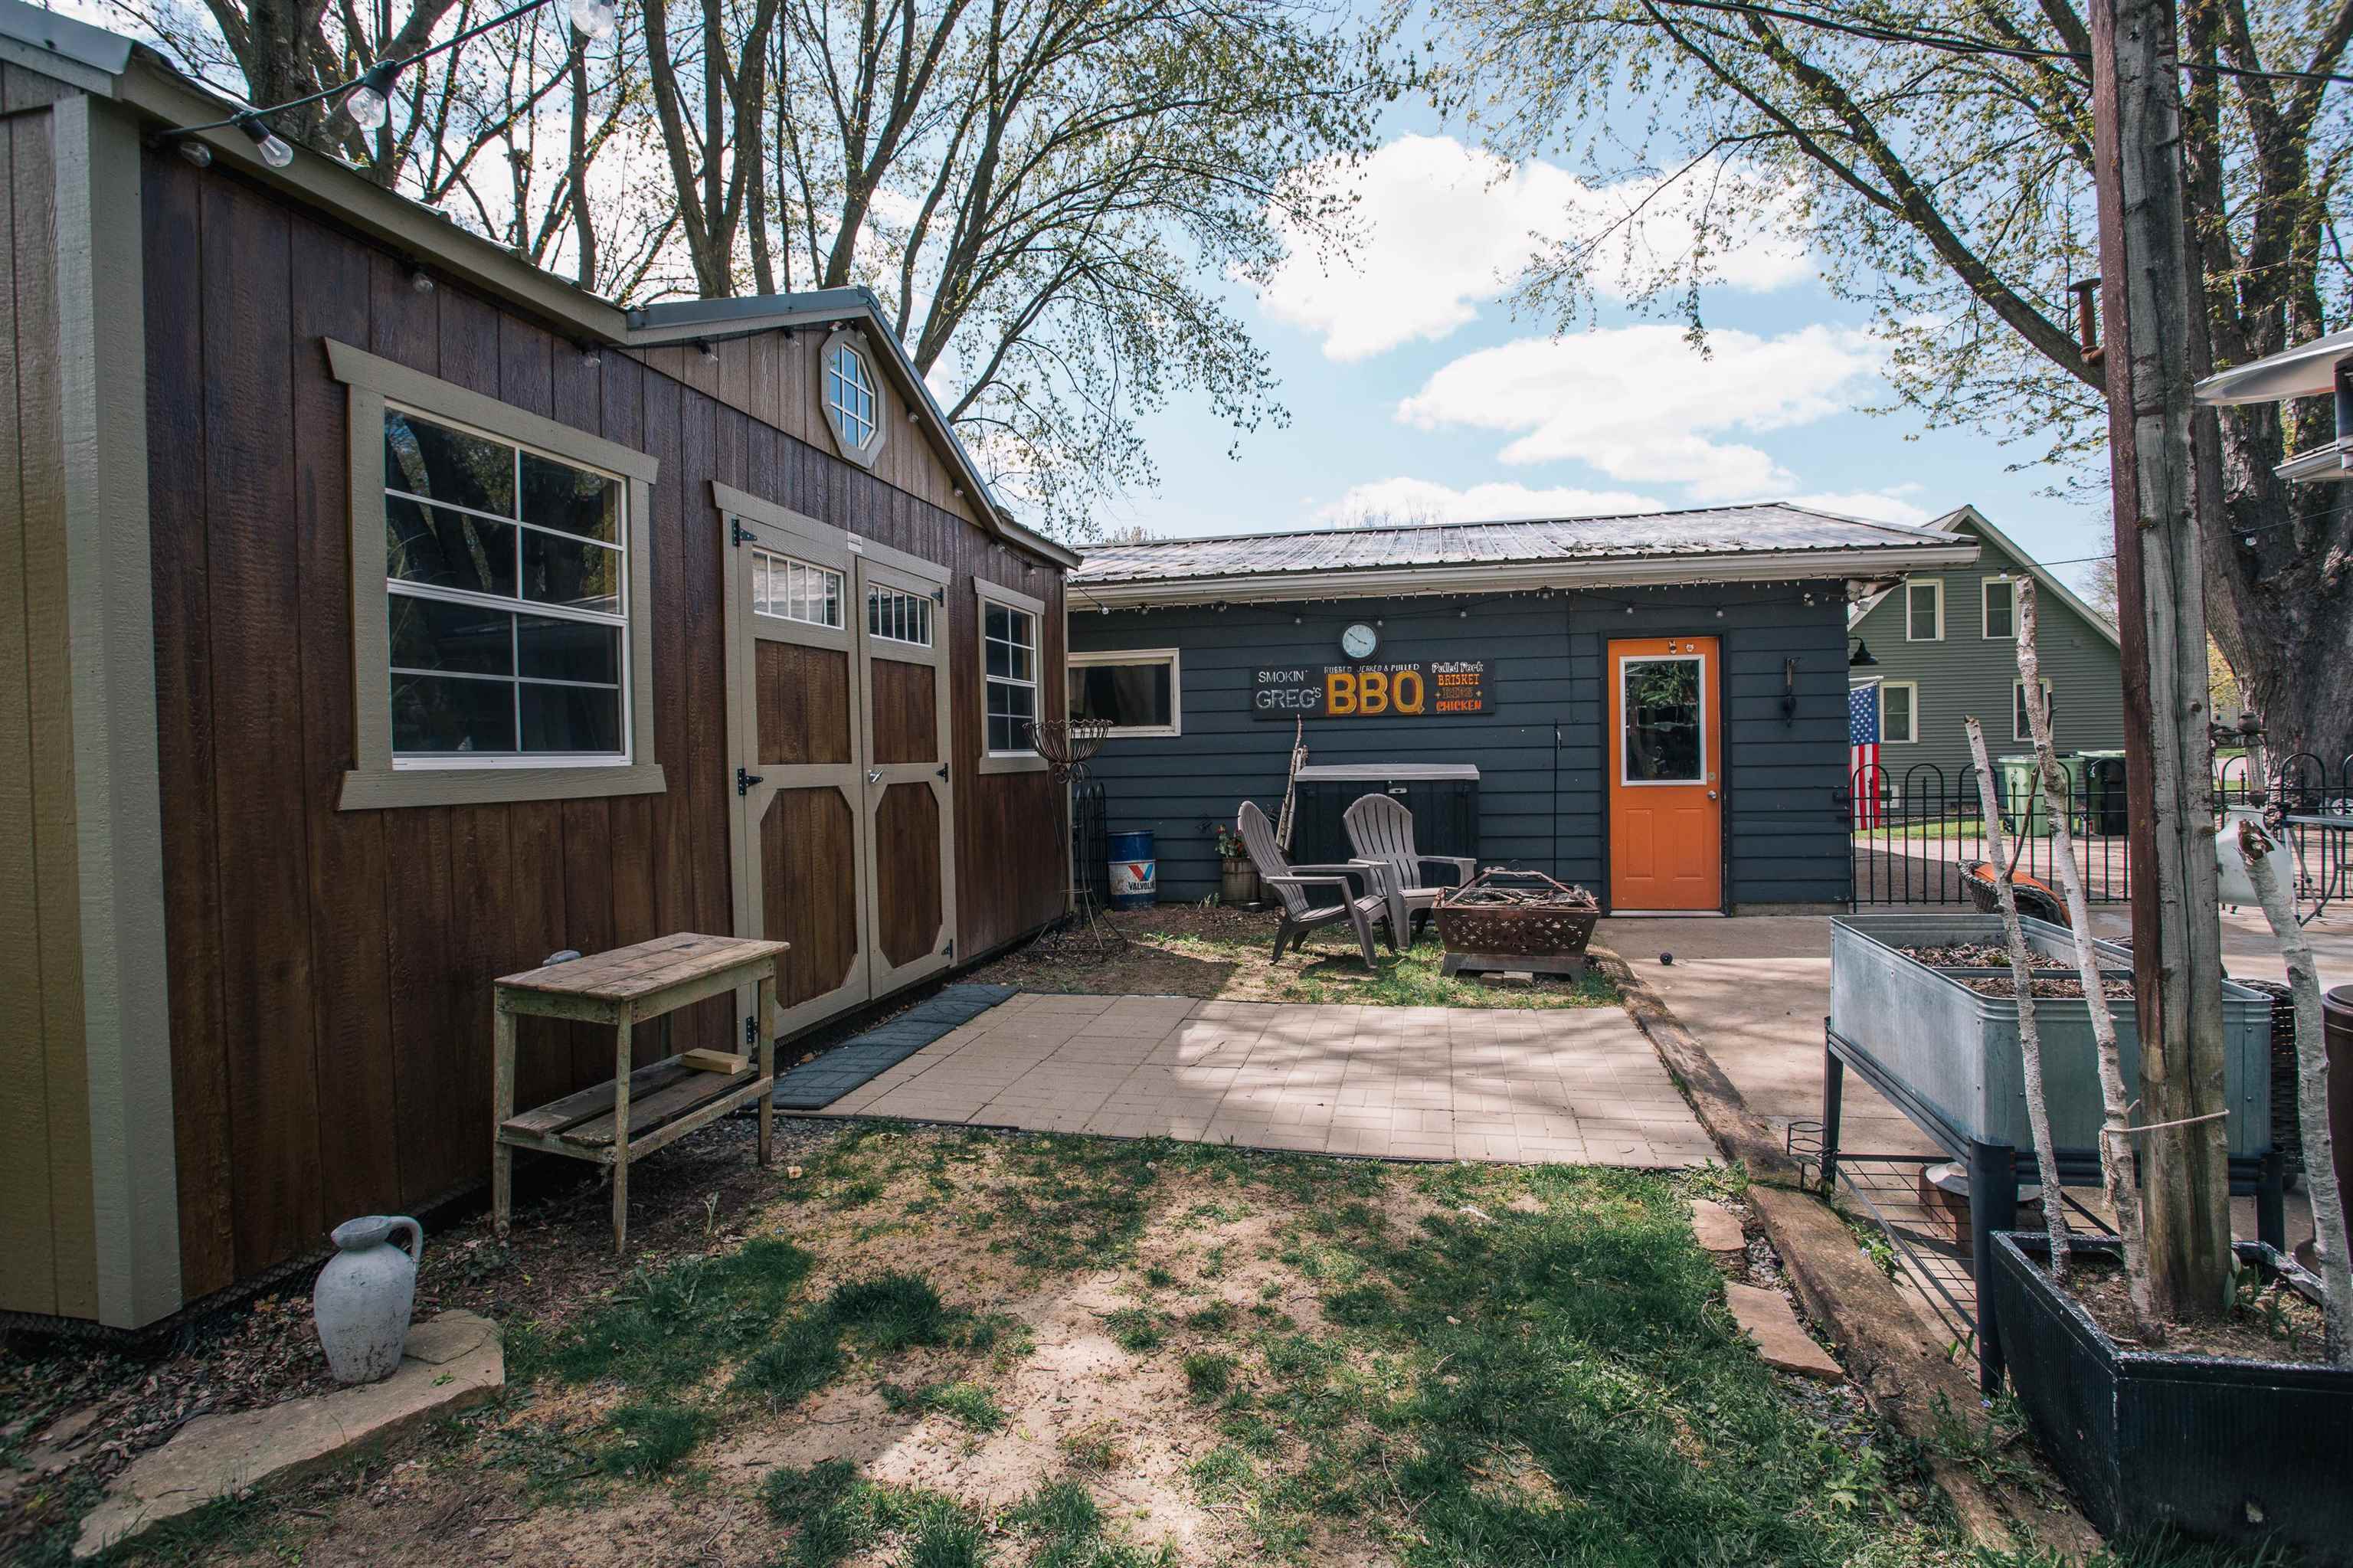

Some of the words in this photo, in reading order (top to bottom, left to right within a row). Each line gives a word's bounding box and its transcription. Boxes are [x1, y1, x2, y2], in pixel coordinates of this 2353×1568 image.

[1390, 663, 1420, 672] PULLED
[1438, 673, 1481, 686] BRISKET
[1326, 671, 1425, 715] BBQ
[1436, 700, 1481, 712] CHICKEN
